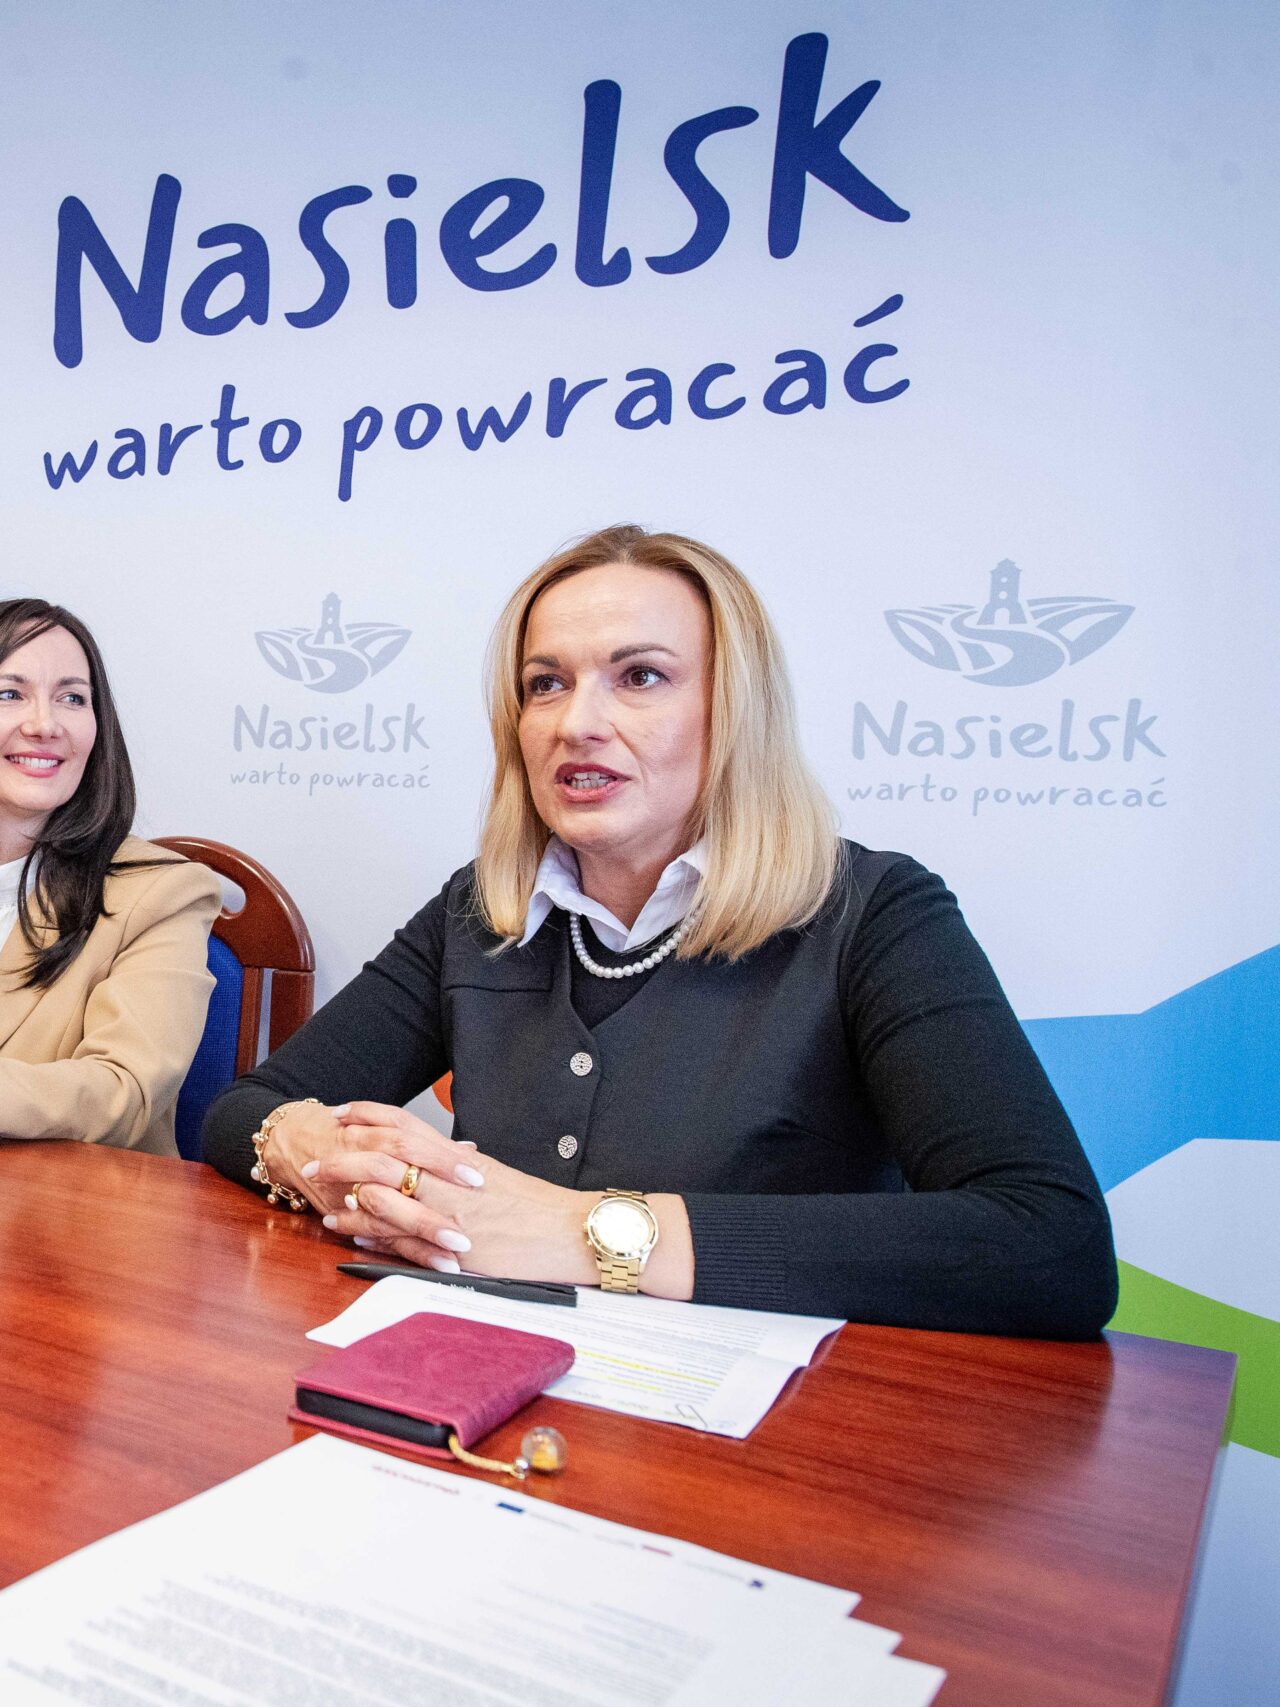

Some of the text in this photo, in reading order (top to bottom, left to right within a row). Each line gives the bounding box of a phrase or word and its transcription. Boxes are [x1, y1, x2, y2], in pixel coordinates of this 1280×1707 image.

[53, 31, 911, 368] Nasielsk
[43, 294, 911, 502] warto powracać
[232, 702, 430, 753] Nasielsk
[851, 698, 1168, 762] Nasielsk
[229, 762, 431, 797] warto powracać
[847, 773, 1168, 817] warto powracać
